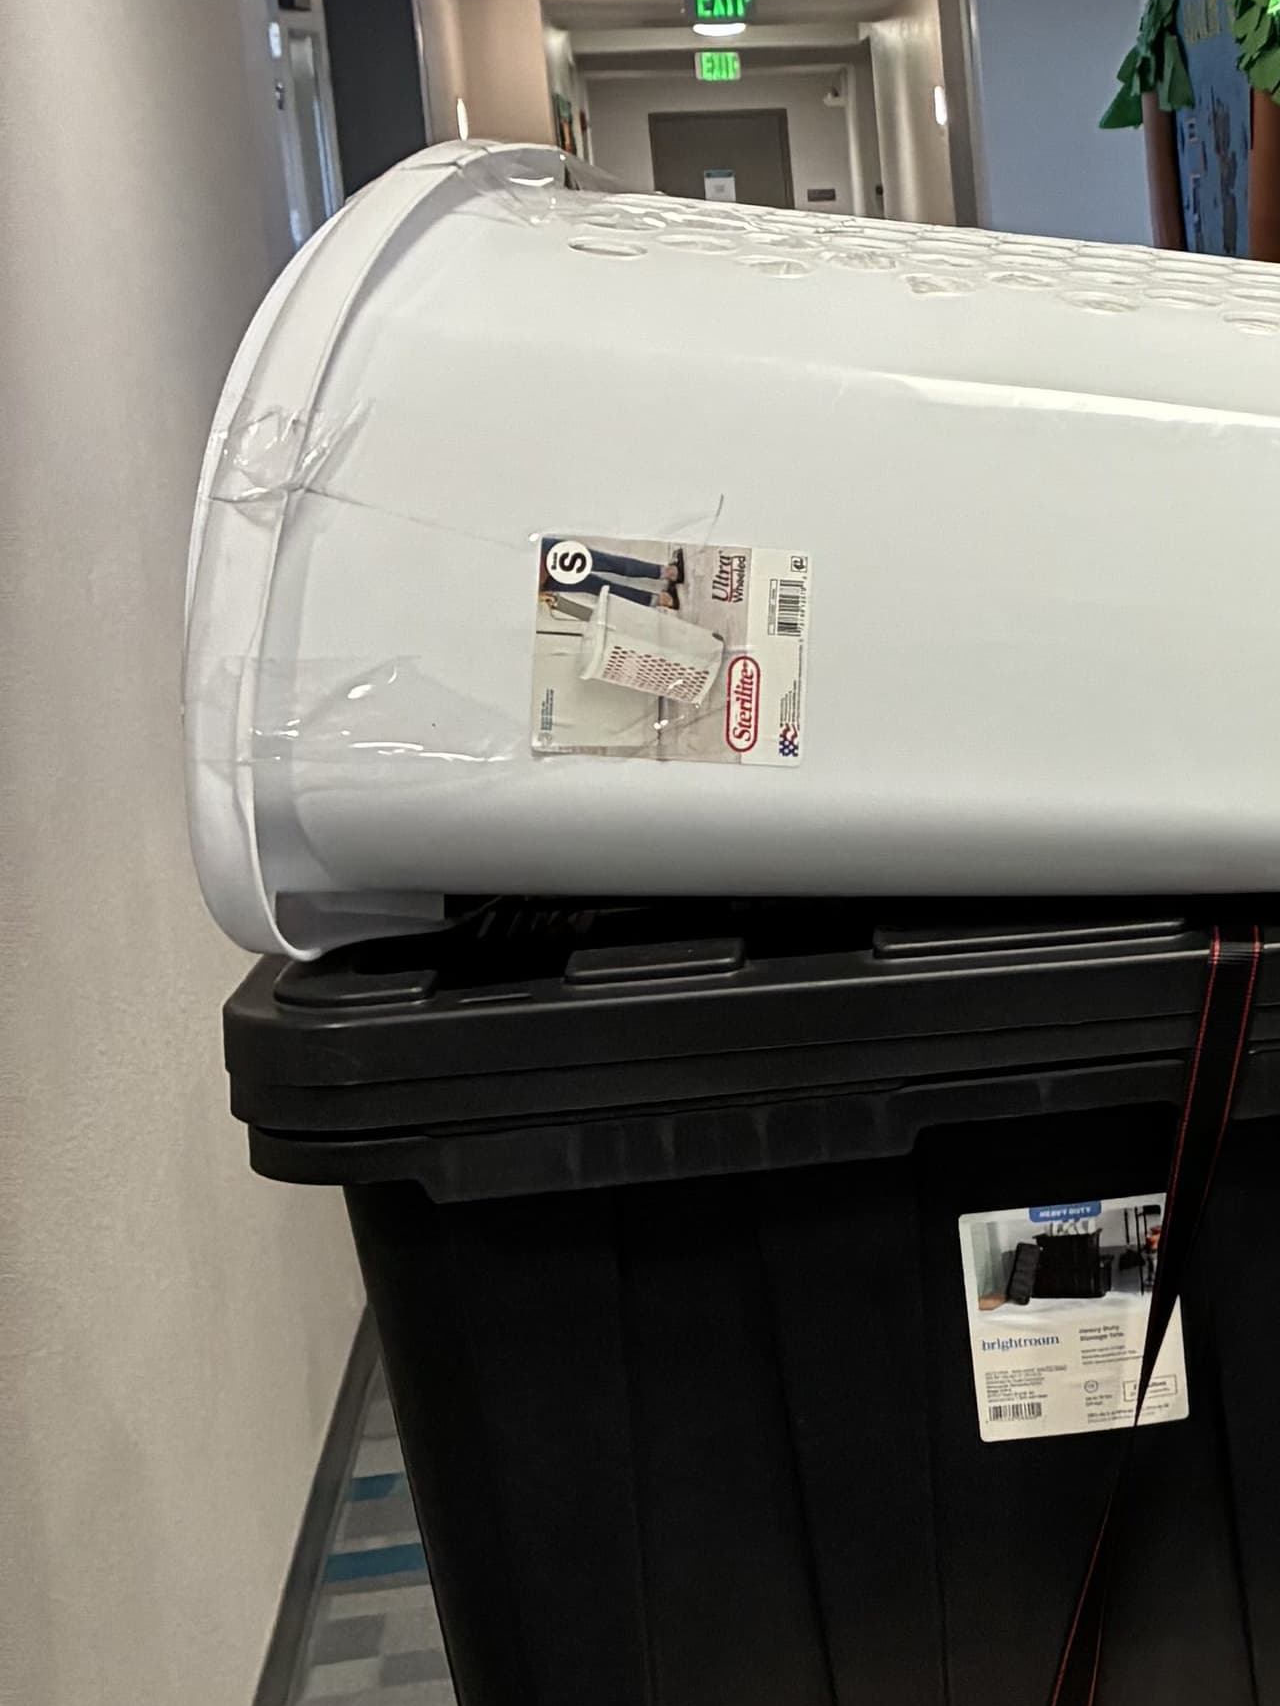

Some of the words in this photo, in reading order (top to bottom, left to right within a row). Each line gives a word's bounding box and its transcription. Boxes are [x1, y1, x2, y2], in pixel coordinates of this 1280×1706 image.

[702, 52, 738, 81] EXIT
[558, 551, 587, 574] S
[711, 555, 731, 602] Ultra
[731, 555, 746, 603] Wheeled
[732, 669, 754, 742] Sterilite
[982, 1336, 1060, 1352] brightroom
